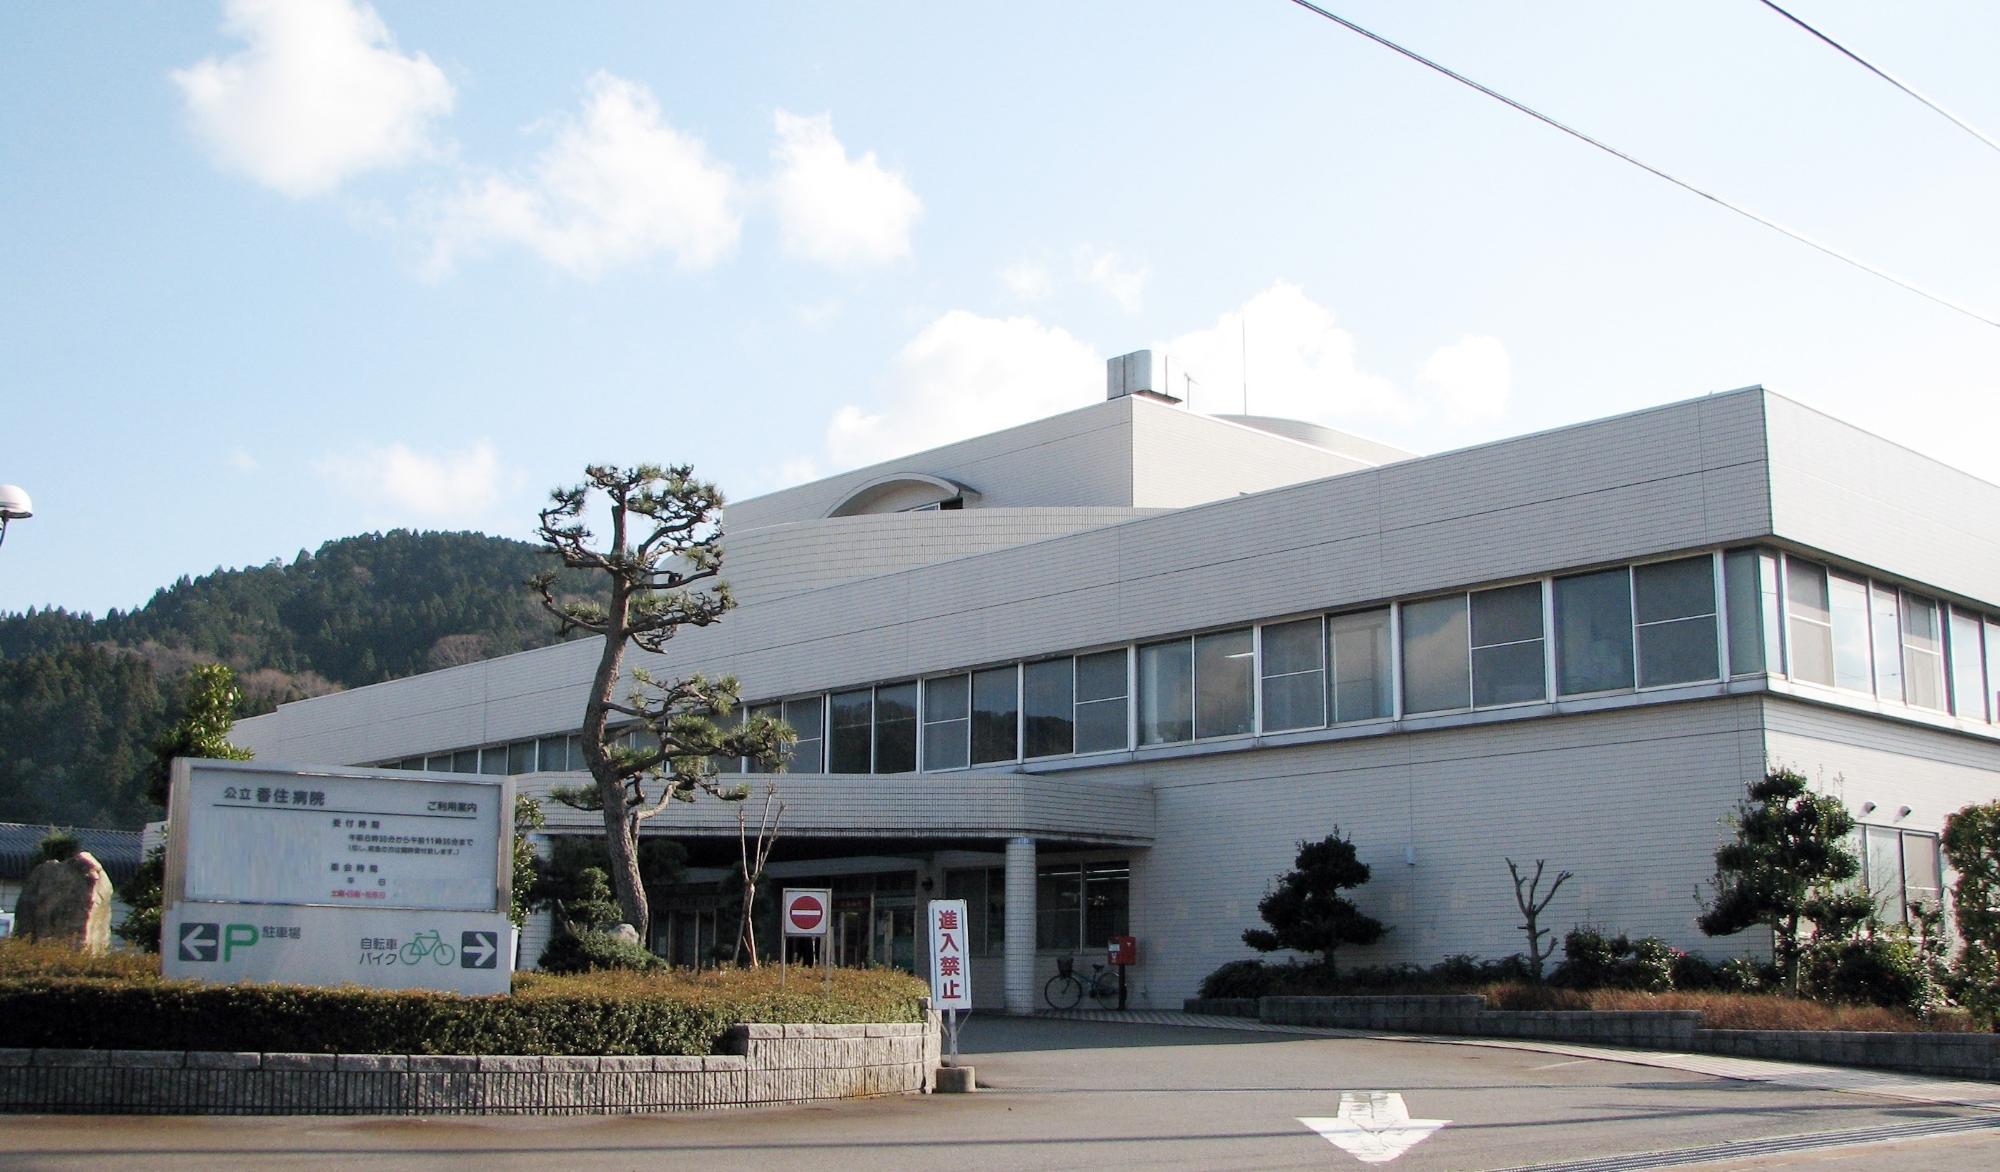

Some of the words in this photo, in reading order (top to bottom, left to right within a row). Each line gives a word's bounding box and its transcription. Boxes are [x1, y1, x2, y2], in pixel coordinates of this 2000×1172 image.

[262, 925, 302, 939] 駐車場
[223, 924, 259, 962] P
[360, 937, 398, 950] 自転車
[359, 952, 398, 966] バイク
[938, 909, 961, 999] 進入禁止
